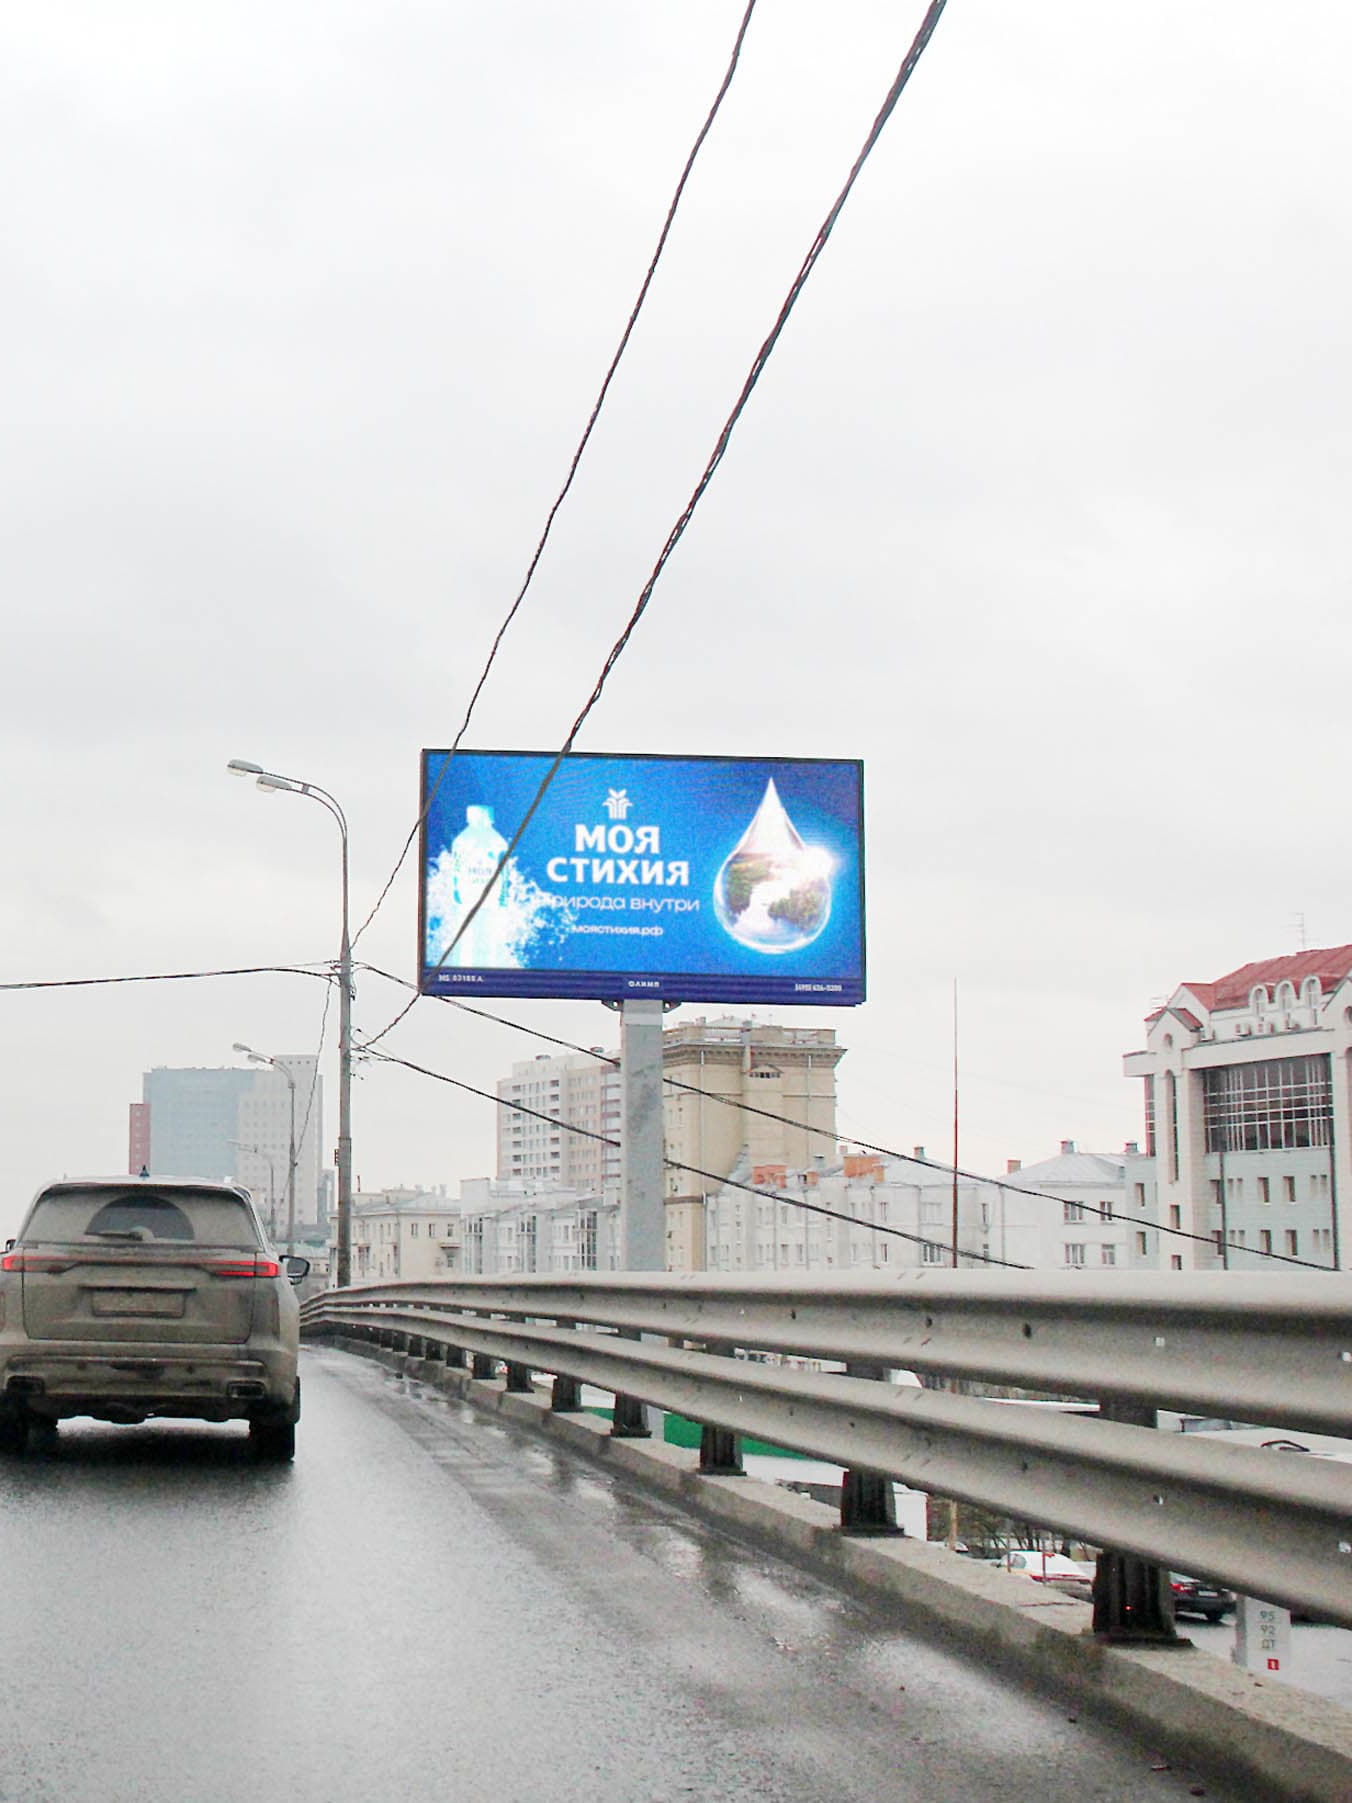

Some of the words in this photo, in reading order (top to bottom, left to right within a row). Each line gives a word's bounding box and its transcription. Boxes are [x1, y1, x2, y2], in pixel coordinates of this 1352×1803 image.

[574, 823, 661, 855] МОЯ
[546, 857, 690, 887] СТИХИЯ
[629, 898, 701, 914] внутри
[1260, 1624, 1275, 1635] 92
